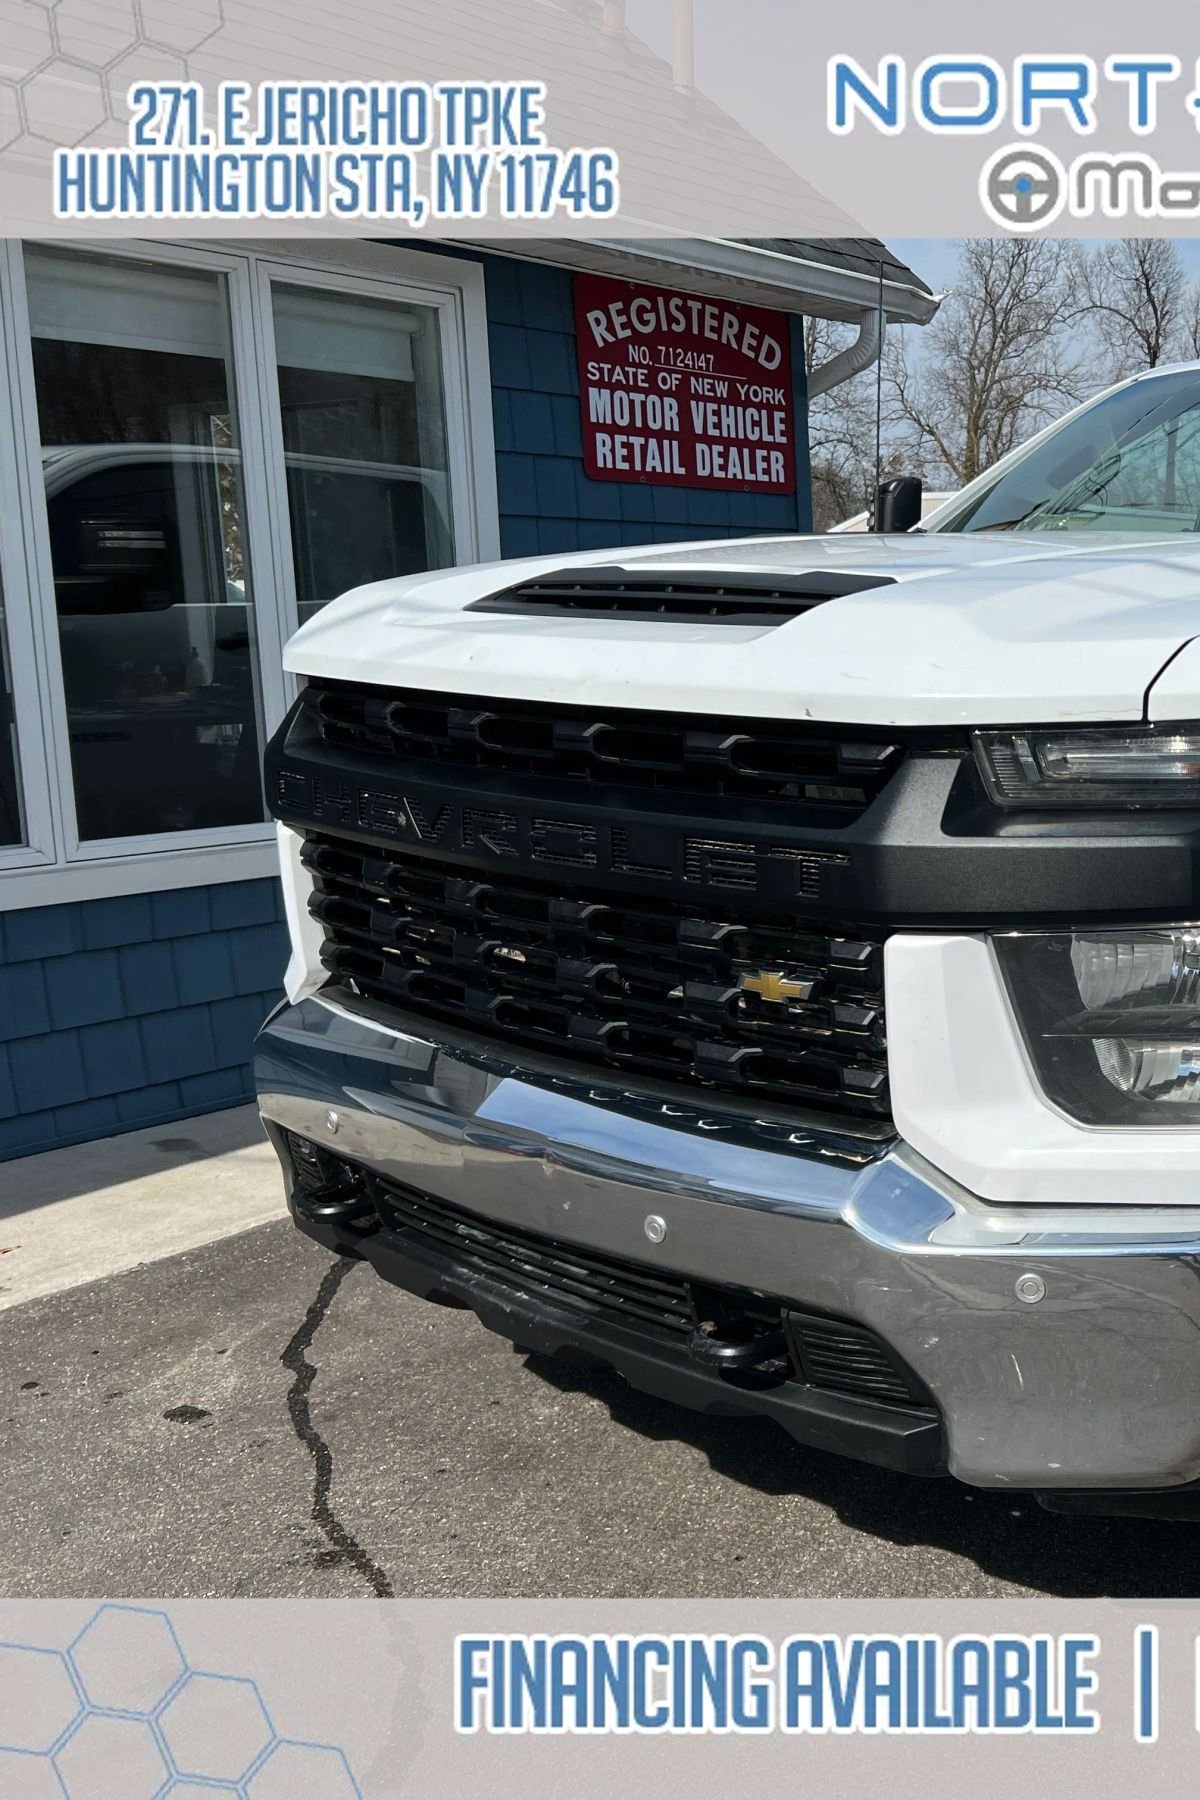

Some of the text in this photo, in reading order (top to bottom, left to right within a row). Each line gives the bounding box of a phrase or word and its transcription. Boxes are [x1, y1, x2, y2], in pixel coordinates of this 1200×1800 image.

[587, 297, 781, 370] REGISTERED
[629, 344, 714, 372] NO. 7124147
[587, 362, 786, 405] STATE OF NEW YORK
[588, 387, 787, 443] MOTOR VEHICLE
[596, 433, 785, 483] RETAIL DEALER
[277, 769, 852, 898] CHEVROLET
